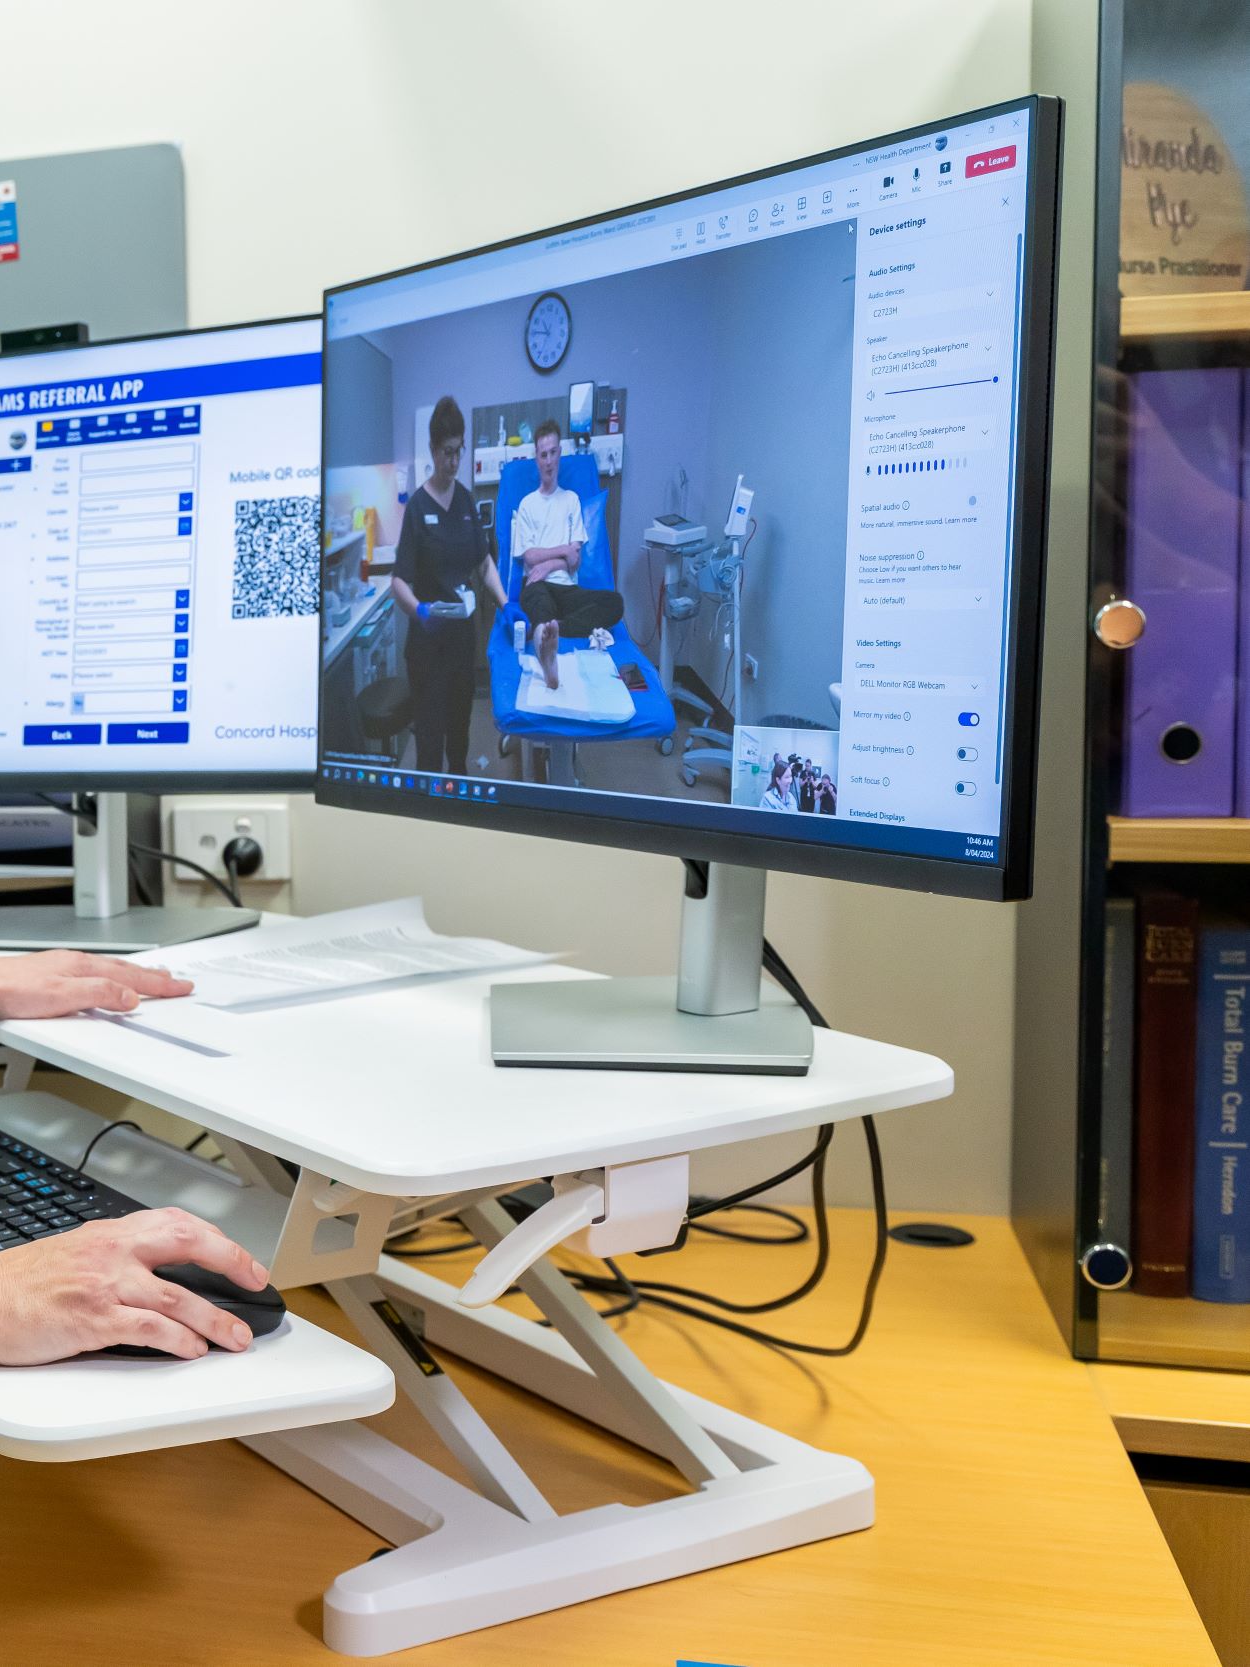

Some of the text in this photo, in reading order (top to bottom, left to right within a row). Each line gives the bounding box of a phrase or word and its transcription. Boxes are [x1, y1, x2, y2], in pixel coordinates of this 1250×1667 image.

[866, 142, 931, 165] NSW Health Department
[1123, 128, 1223, 174] iranda
[988, 155, 1010, 166] Leave
[937, 178, 953, 188] Share
[911, 186, 922, 194] Mic
[879, 192, 898, 201] Camera
[846, 201, 860, 209] More
[821, 207, 833, 216] Apps
[869, 217, 927, 236] Device settings
[868, 262, 916, 278] Audio Settings
[1122, 260, 1155, 274] urse
[868, 287, 905, 300] Audio devices
[873, 306, 898, 318] C2723H
[866, 336, 888, 345] Speaker
[871, 342, 969, 363] Echo Cancelling Speakerphone
[871, 363, 900, 376] (C2723H)
[29, 383, 106, 409] REFERRAL
[110, 379, 144, 401] APP
[864, 414, 896, 423] Microphone
[870, 424, 966, 442] Echo Cancelling Speakerphone
[869, 444, 897, 455] (C2723H)
[229, 469, 272, 484] Mobile
[274, 467, 293, 481] QR
[861, 503, 901, 513] Spatial audio
[945, 516, 961, 525] Learn
[859, 553, 915, 563] Noise suppression
[858, 565, 879, 573] Choose
[879, 565, 890, 573] Low
[896, 566, 907, 574] you
[922, 564, 940, 572] others
[948, 563, 962, 571] hear
[875, 576, 891, 584] Learn
[863, 596, 906, 606] Auto (default)
[875, 640, 901, 649] Settings
[855, 661, 875, 669] Camera
[860, 679, 946, 690] DELL Monitor RGB Webcam
[853, 711, 901, 720] Mirror my video
[51, 728, 159, 741] Back Next
[215, 725, 275, 740] Concord
[852, 743, 905, 755] Adjust brightness
[850, 775, 881, 785] Soft focus
[850, 809, 906, 823] Extended Displays
[966, 836, 994, 846] 10:46 AM
[965, 848, 994, 859] 8/04/2024
[1224, 987, 1246, 1034] Total
[1222, 1040, 1244, 1084] Burn
[1220, 1092, 1243, 1134] Care
